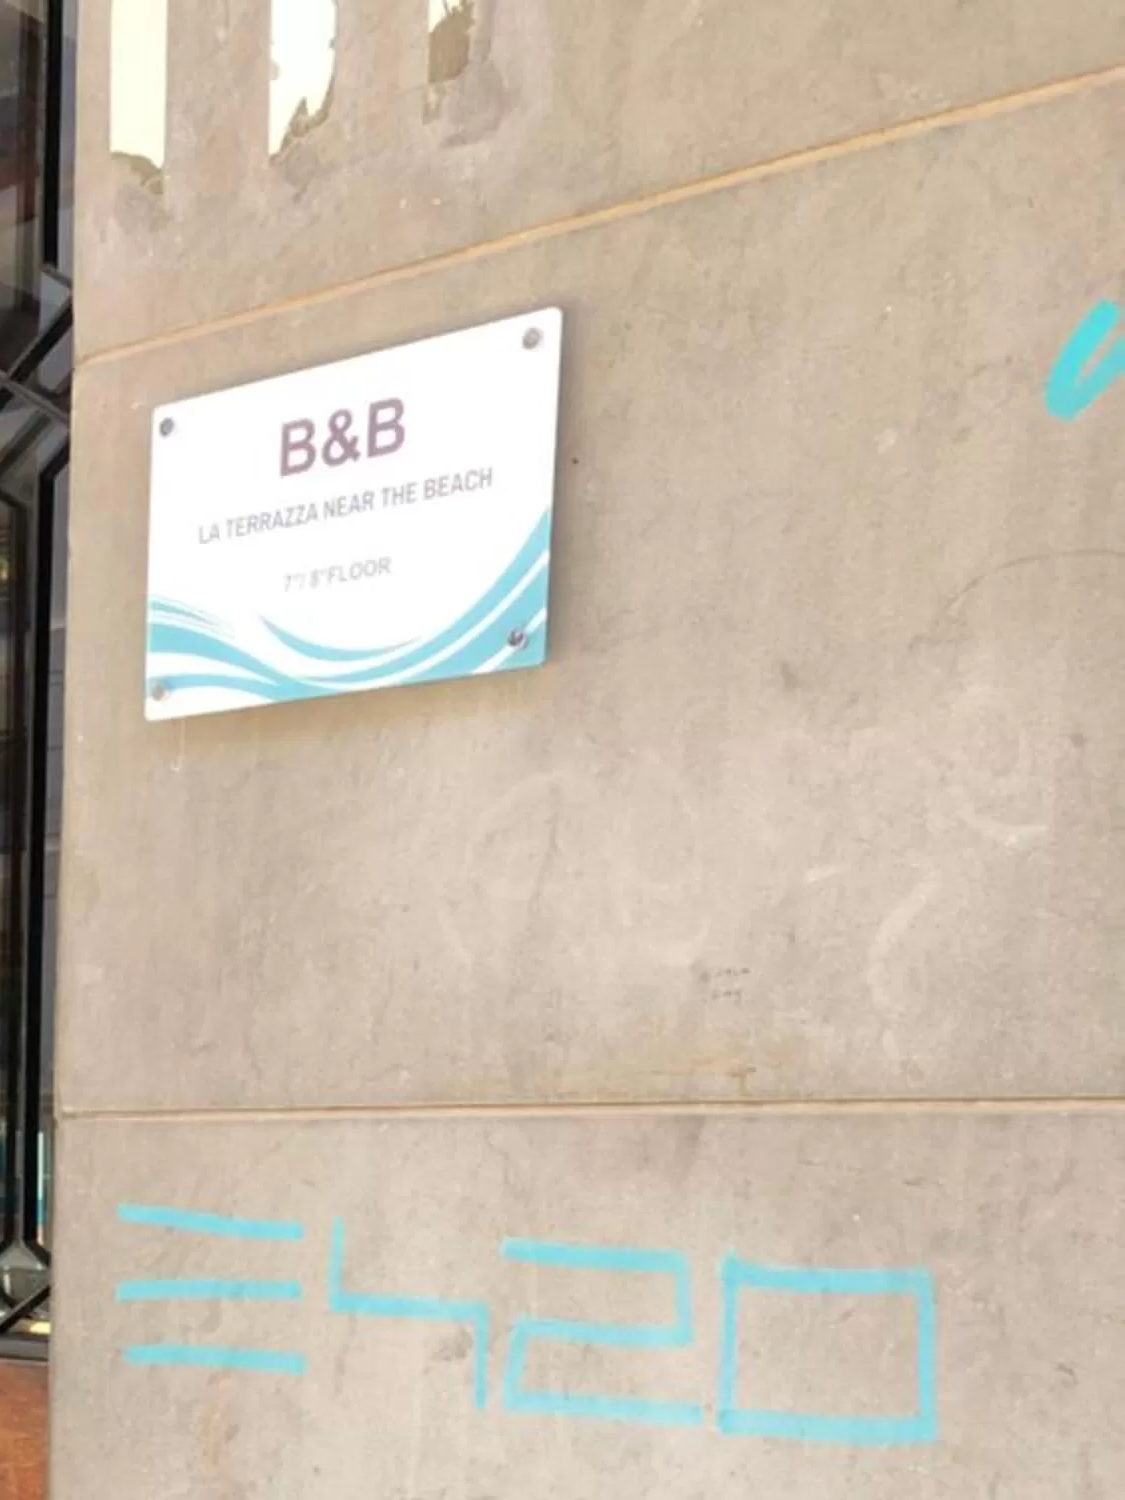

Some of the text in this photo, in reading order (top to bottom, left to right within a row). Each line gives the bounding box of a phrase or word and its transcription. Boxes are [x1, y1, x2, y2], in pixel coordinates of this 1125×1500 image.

[280, 397, 406, 477] B&B
[198, 467, 493, 545] LA TERRAZZA NEAR THE BEACH
